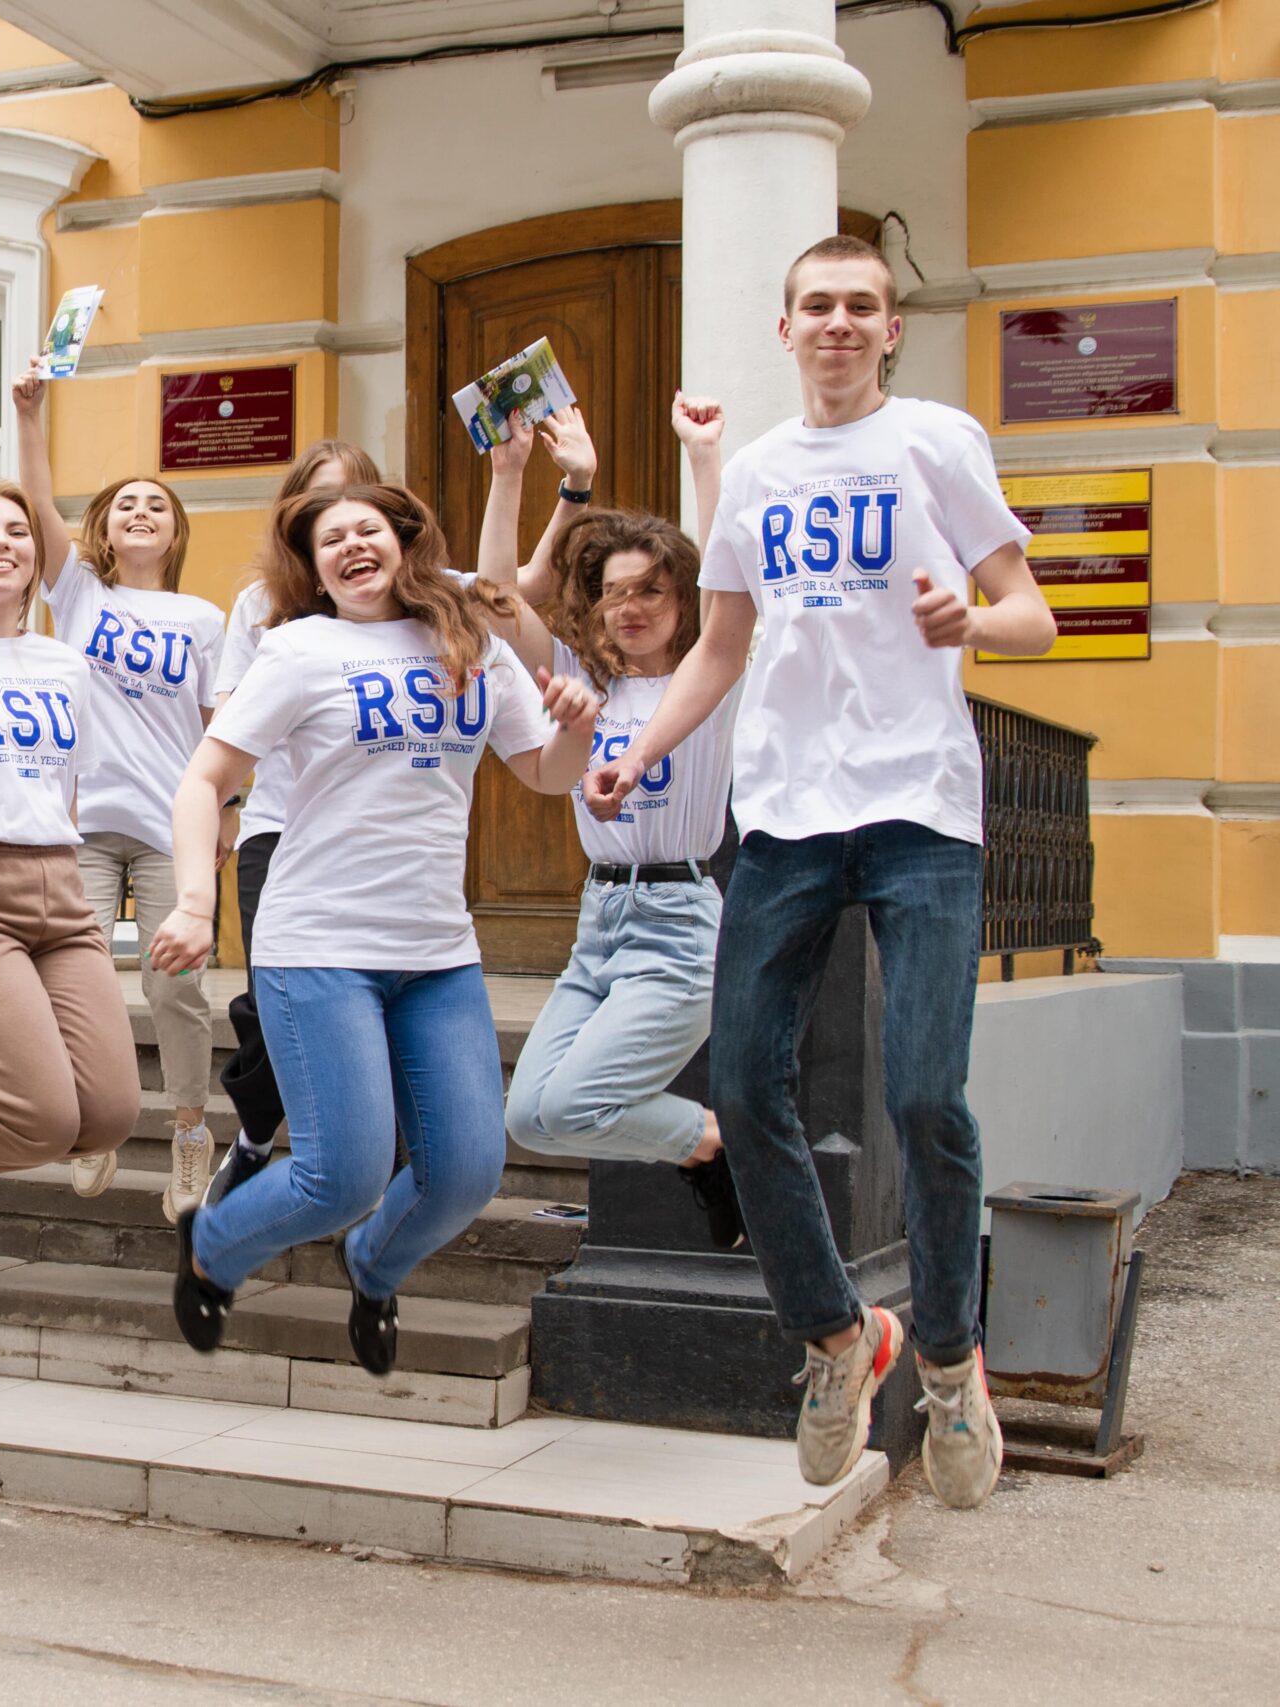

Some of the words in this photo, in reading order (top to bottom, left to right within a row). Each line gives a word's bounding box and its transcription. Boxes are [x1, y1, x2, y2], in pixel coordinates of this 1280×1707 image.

[833, 473, 899, 487] UNIVERSITY
[758, 487, 902, 585] RSU
[840, 579, 889, 592] YESENIN
[822, 596, 842, 606] 1915
[83, 608, 193, 688] RSU
[387, 655, 422, 666] STATE
[146, 682, 179, 699] YESENIN
[342, 664, 488, 746] RSU
[367, 741, 405, 756] NAMED
[407, 742, 428, 753] FOR
[440, 742, 475, 754] YESENIN
[632, 797, 669, 811] YESENIN
